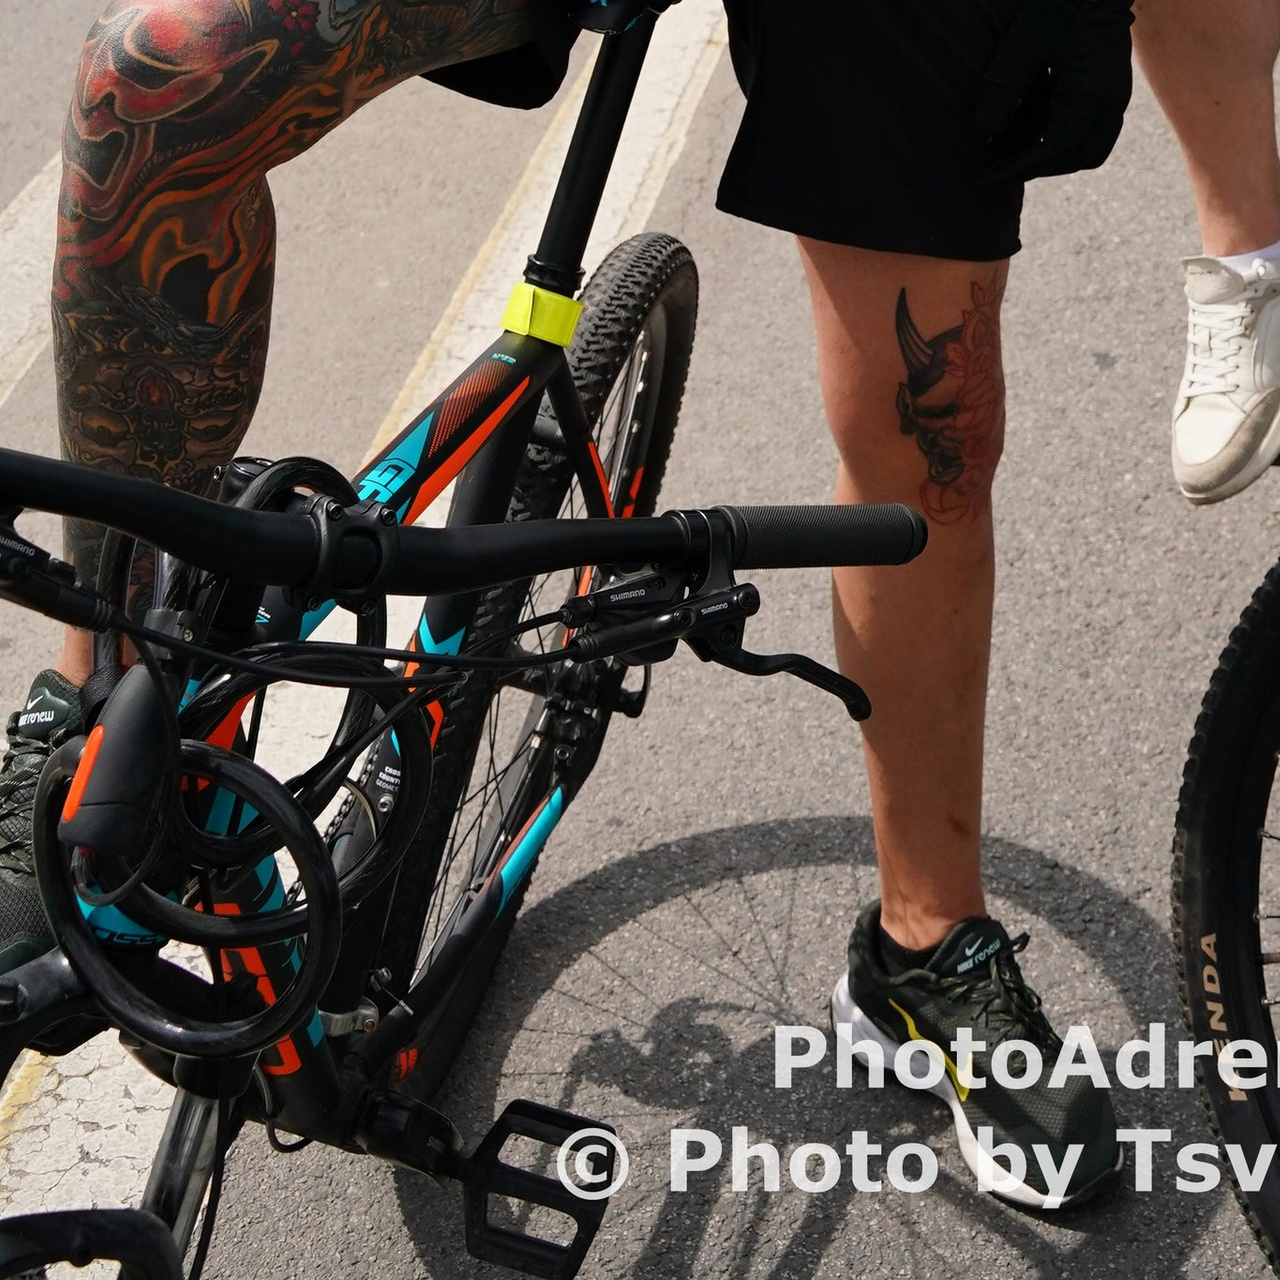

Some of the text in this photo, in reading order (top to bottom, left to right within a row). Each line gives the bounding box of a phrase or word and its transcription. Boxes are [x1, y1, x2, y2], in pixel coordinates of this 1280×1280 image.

[610, 588, 646, 603] SHIMANO
[701, 602, 728, 616] SHIMANO
[974, 938, 1001, 964] renew
